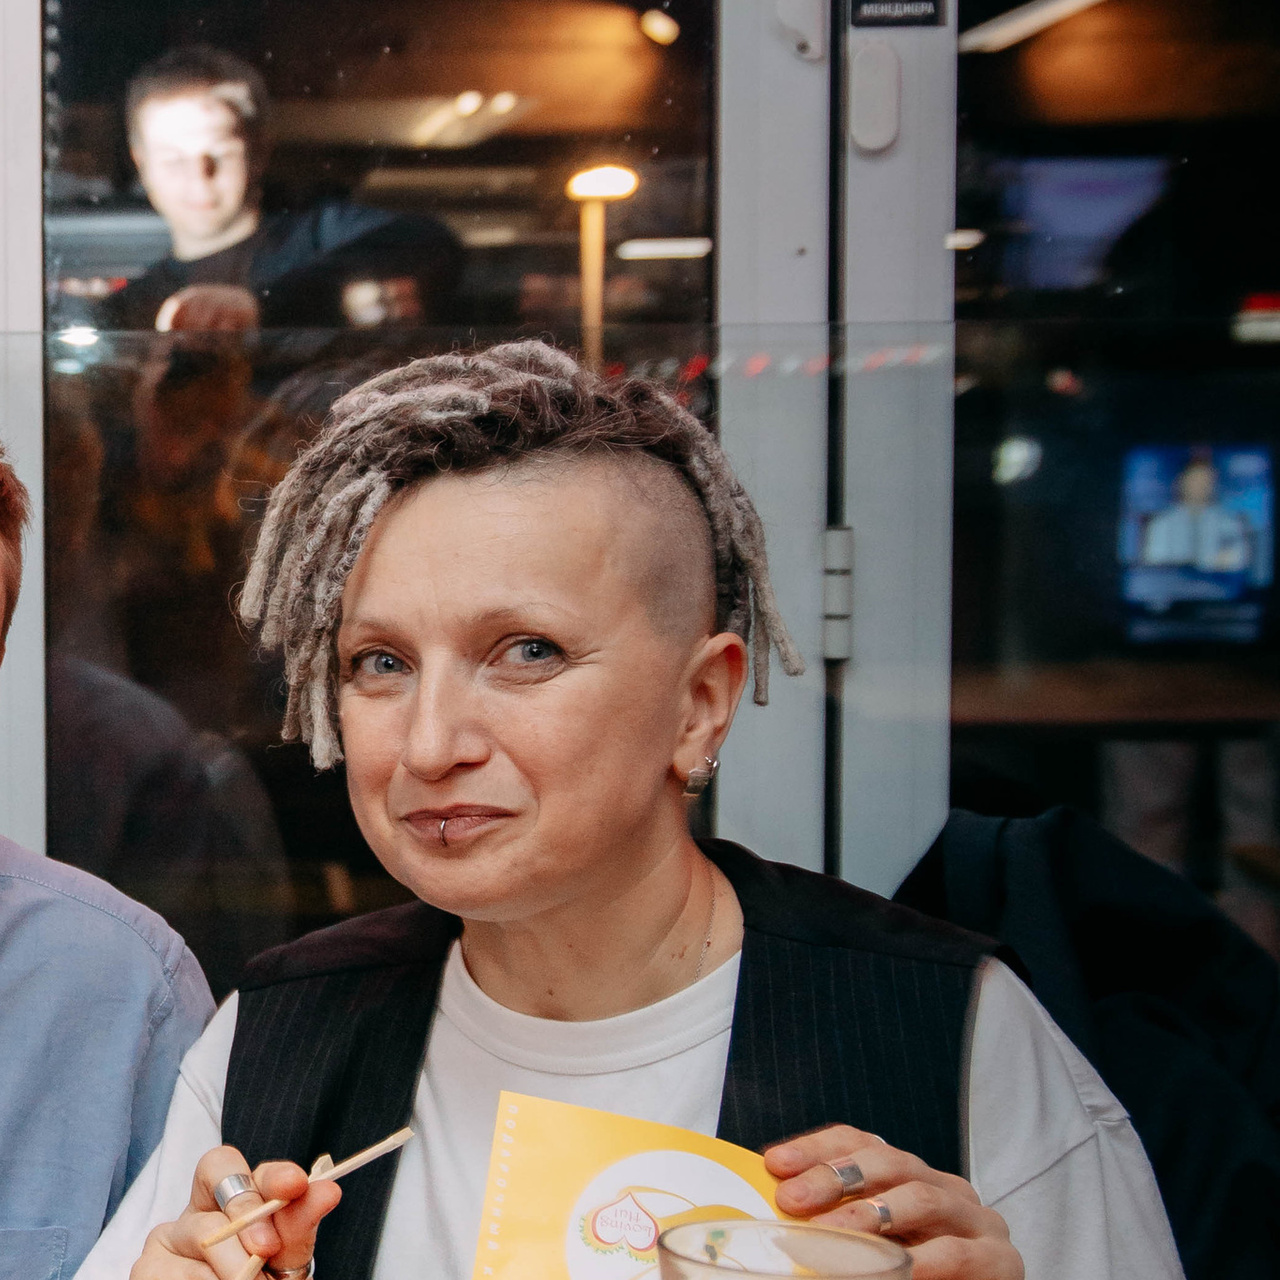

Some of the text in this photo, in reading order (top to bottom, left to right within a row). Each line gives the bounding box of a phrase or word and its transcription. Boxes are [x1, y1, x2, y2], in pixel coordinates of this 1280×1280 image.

[860, 2, 935, 17] МЕНЕДЖЕРА
[614, 1208, 640, 1223] Hut
[600, 1215, 652, 1237] Loving
